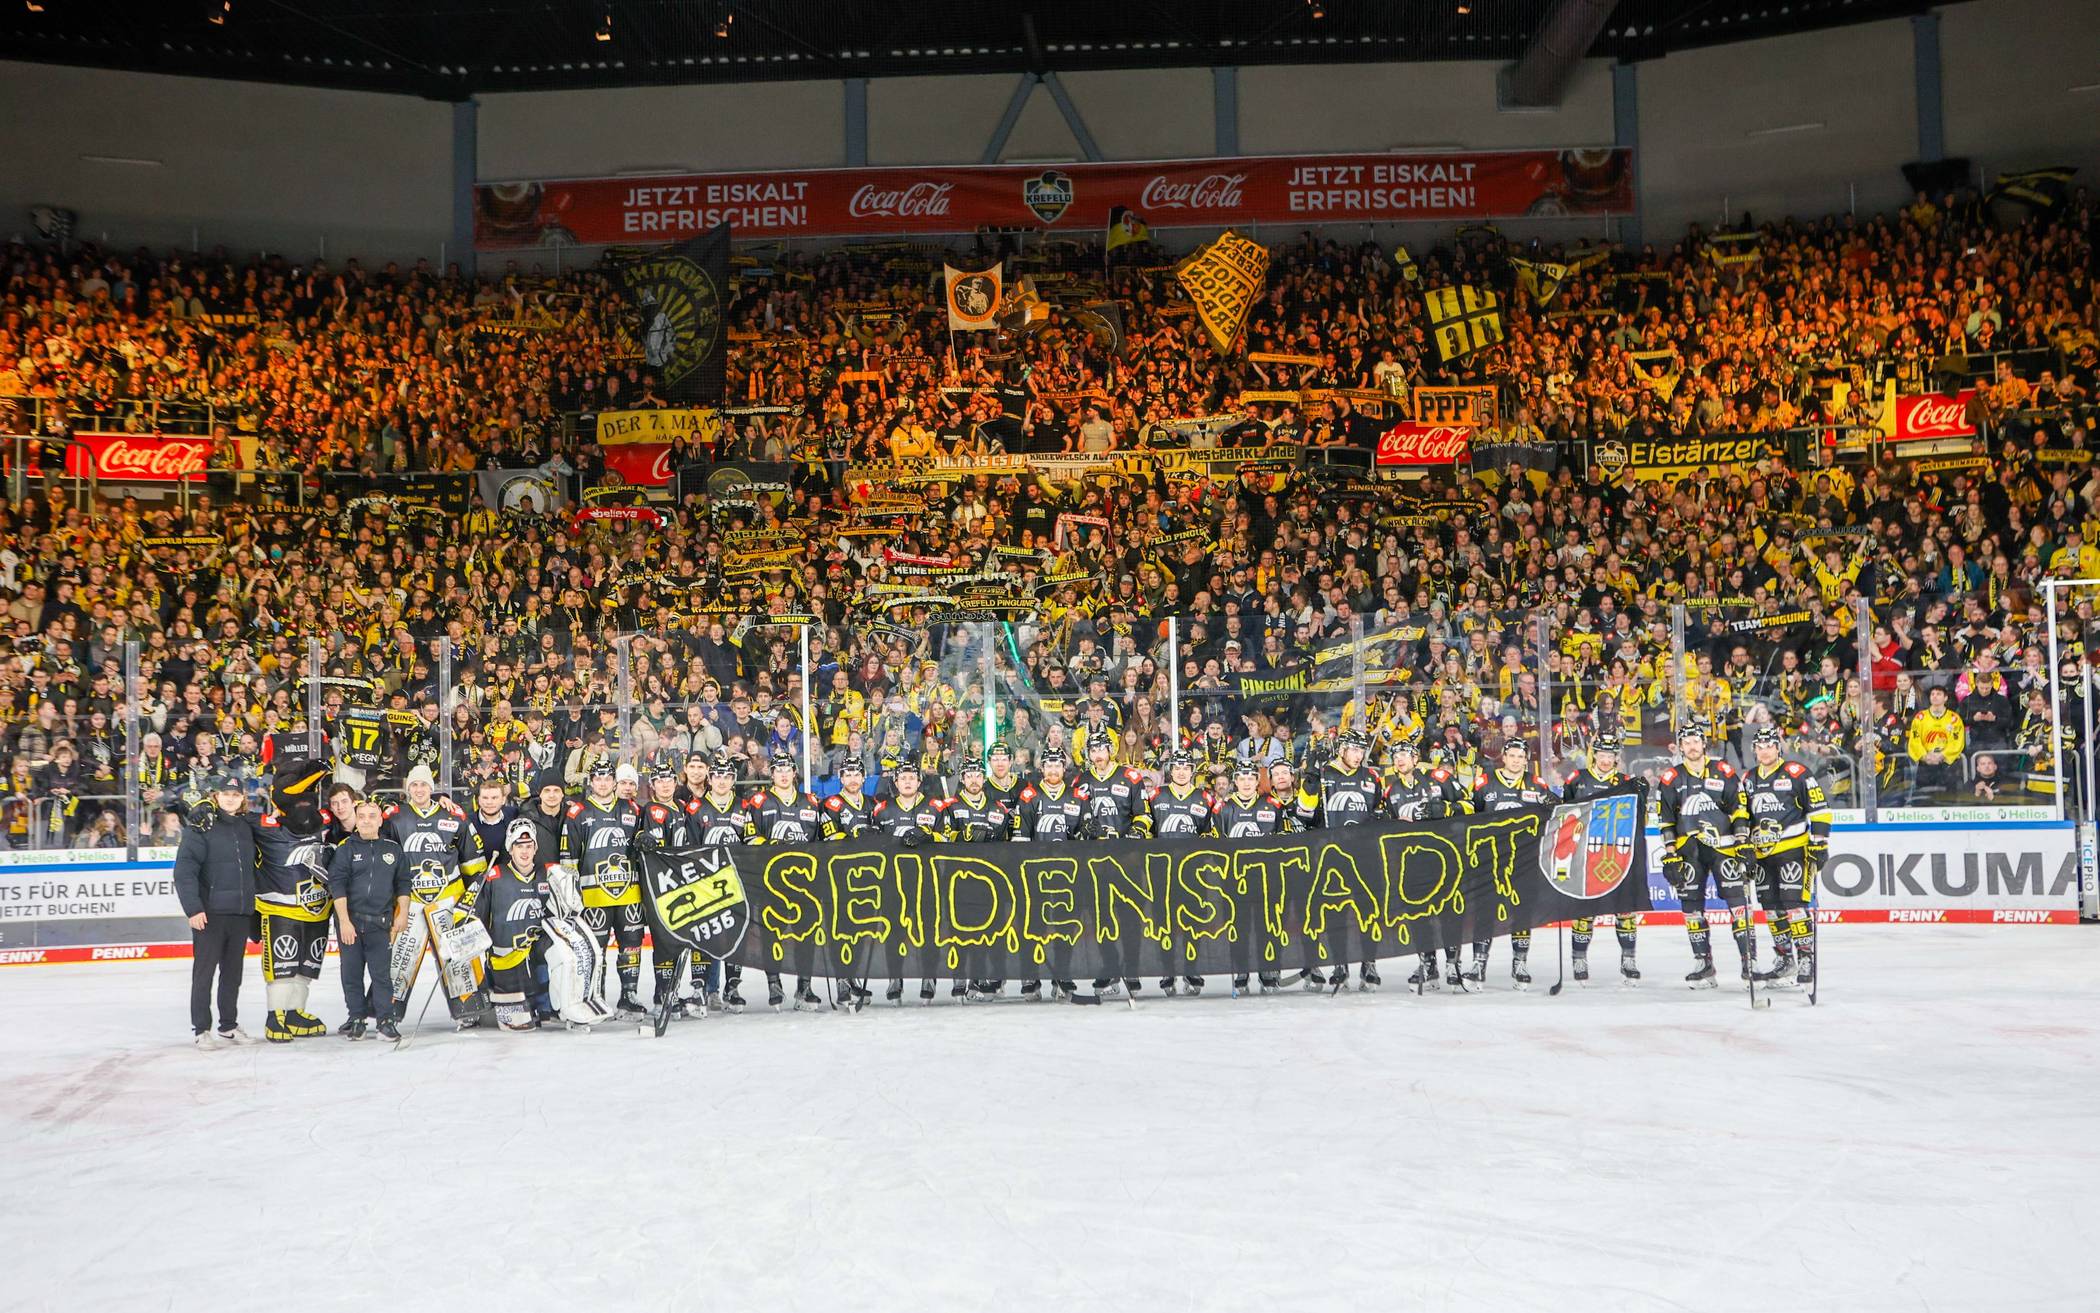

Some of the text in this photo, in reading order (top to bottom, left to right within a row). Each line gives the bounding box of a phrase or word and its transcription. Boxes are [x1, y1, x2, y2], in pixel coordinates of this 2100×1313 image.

[1287, 162, 1478, 188] JETZT EISKALT
[623, 182, 808, 207] JETZT EISKALT
[1025, 193, 1072, 203] KREFELD
[1140, 174, 1248, 210] Coca-Cola
[849, 183, 955, 218] Coca-Cola
[1288, 185, 1477, 212] ERFRISCHEN!
[624, 206, 807, 232] ERFRISCHEN!
[1419, 396, 1468, 422] PPP
[603, 416, 640, 438] DER
[650, 415, 665, 430] 7.
[1377, 427, 1470, 458] oca-Cola
[1932, 443, 1938, 452] A
[99, 440, 207, 475] Coca-Cola
[1631, 438, 1766, 466] Eistänzer
[992, 456, 1008, 466] CS
[1390, 470, 1396, 479] B
[258, 505, 320, 516] PENGUINS
[595, 509, 638, 518] believe
[1387, 519, 1409, 527] WALK
[997, 547, 1034, 555] PINGUINE
[1044, 571, 1089, 583] PINGUINE
[960, 600, 995, 608] KREFELD
[1240, 671, 1307, 699] PINGUINE
[352, 728, 379, 750] 17
[285, 744, 309, 753] MÜLLER
[1808, 788, 1824, 802] 96
[1699, 801, 1719, 812] SWK
[1763, 802, 1786, 812] SWK
[1897, 811, 1934, 821] Helios
[1953, 810, 1990, 820] Helios
[2009, 809, 2048, 820] Helios
[822, 822, 836, 836] 21
[611, 838, 630, 847] SWK
[787, 832, 808, 842] SWK
[425, 843, 447, 853] SWK
[22, 853, 60, 863] Helios
[78, 852, 115, 860] Helios
[657, 849, 726, 893] K.E.V.
[412, 879, 447, 888] KREFELD
[598, 873, 630, 882] KREFELD
[29, 882, 68, 899] FÜR
[76, 882, 125, 898] ALLE
[762, 814, 1540, 955] SEIDENSTADT
[48, 902, 115, 915] BUCHEN!
[1889, 910, 1948, 923] PENNY.
[1993, 911, 2052, 923] PENNY.
[690, 910, 735, 942] 1936
[446, 928, 465, 938] CCM
[92, 947, 149, 960] PENNY.
[400, 938, 416, 972] KREFELD
